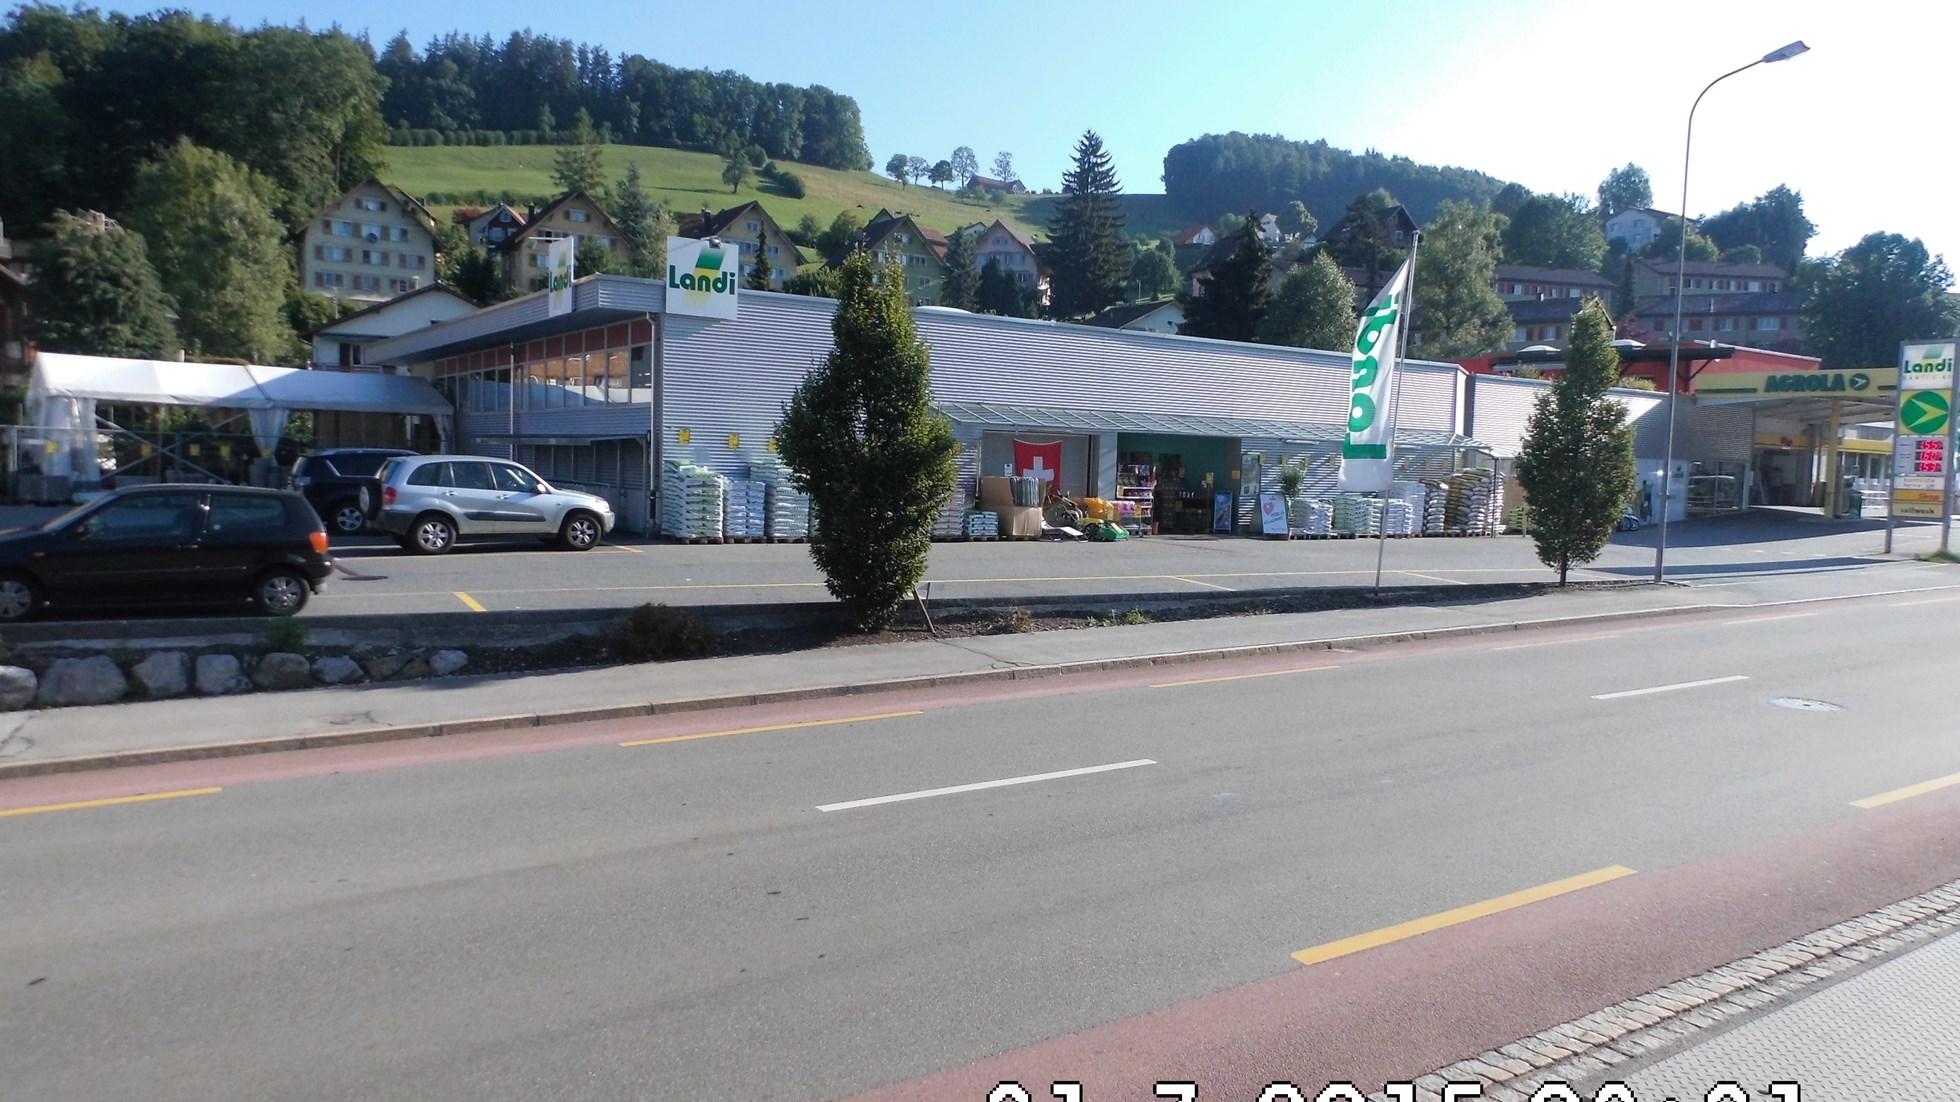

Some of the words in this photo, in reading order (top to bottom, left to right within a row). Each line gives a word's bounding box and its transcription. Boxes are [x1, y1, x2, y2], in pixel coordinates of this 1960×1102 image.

[550, 264, 572, 293] Landi
[669, 264, 736, 295] Landi
[1904, 358, 1953, 374] Landi
[1764, 373, 1846, 393] AGROLA
